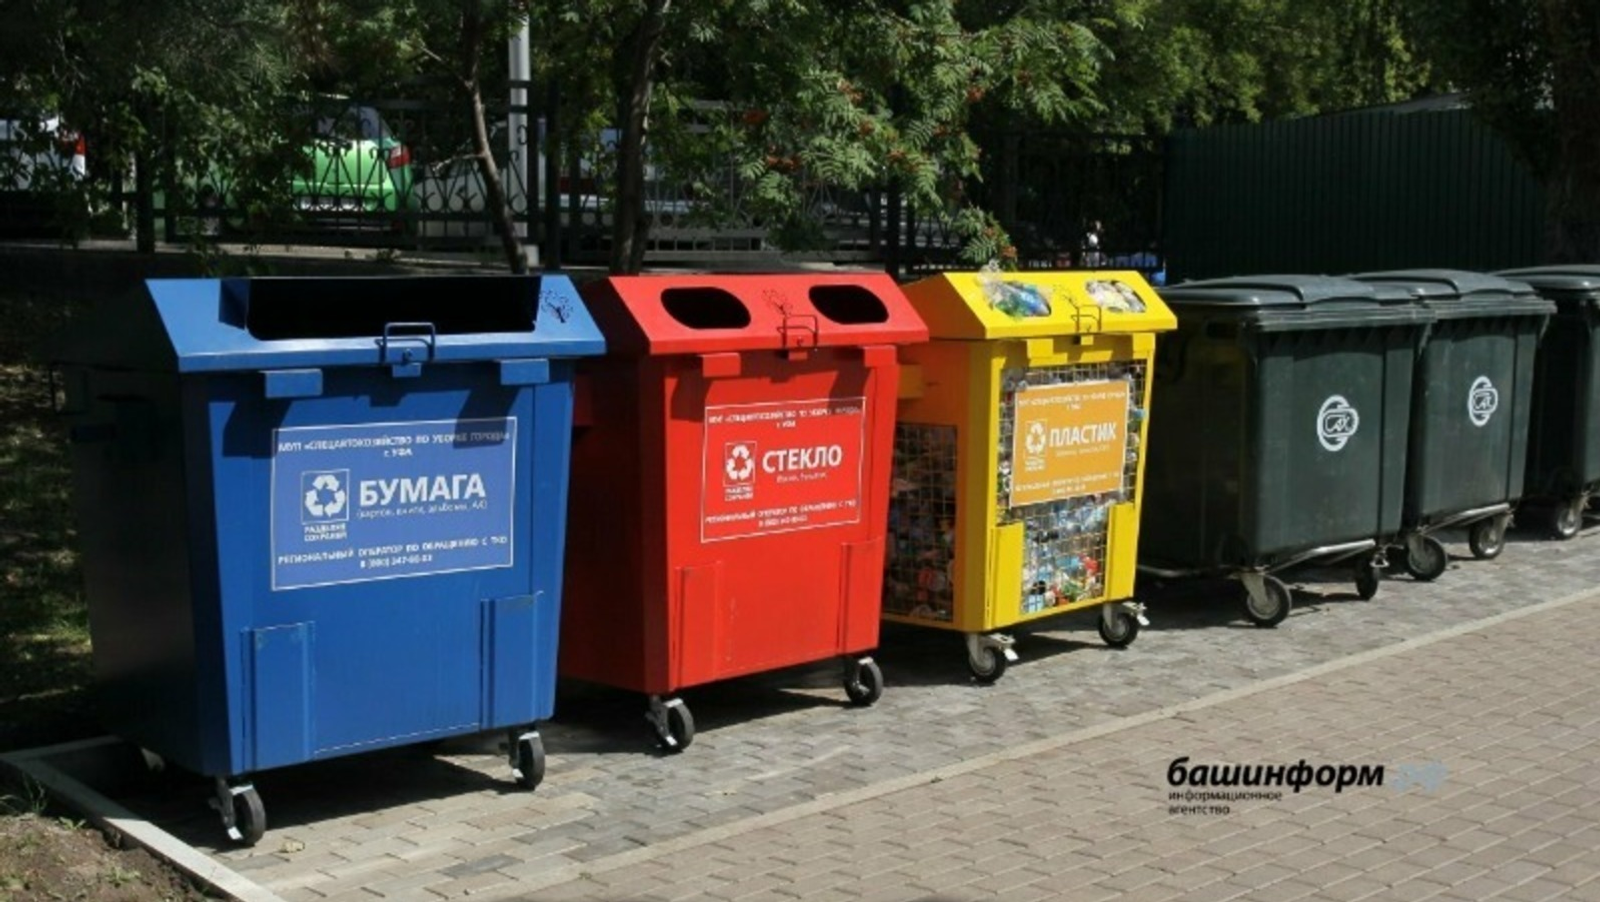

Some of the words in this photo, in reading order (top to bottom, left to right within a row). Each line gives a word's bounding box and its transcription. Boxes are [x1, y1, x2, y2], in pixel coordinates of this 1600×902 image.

[1049, 421, 1117, 448] ПЛАСТИК
[762, 444, 843, 474] СТЕКЛО
[360, 473, 486, 507] БУМАГА
